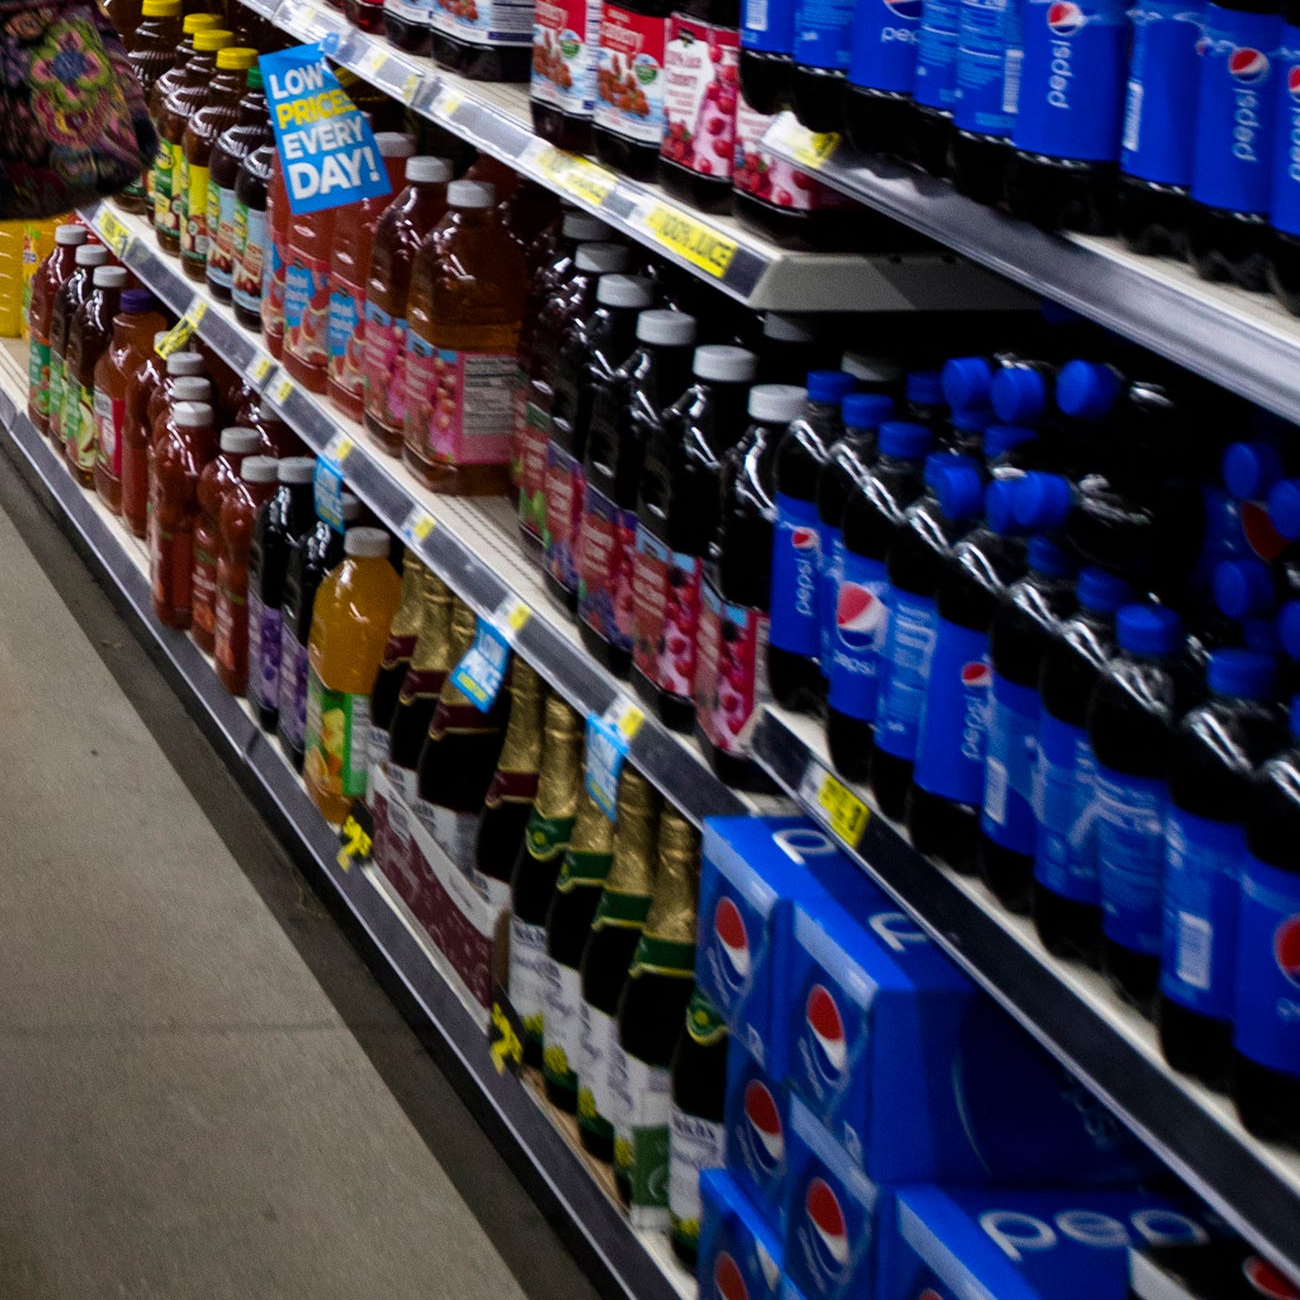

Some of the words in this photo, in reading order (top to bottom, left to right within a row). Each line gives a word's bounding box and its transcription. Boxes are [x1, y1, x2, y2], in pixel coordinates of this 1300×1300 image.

[880, 25, 919, 44] pep
[269, 62, 324, 100] LOW
[1047, 40, 1072, 109] pepsi
[282, 115, 364, 160] EVERY
[1233, 88, 1259, 162] pepsi
[287, 146, 381, 200] DAY!
[691, 225, 733, 268] JUICE
[796, 557, 815, 617] pepsi
[978, 1208, 1210, 1263] pep
